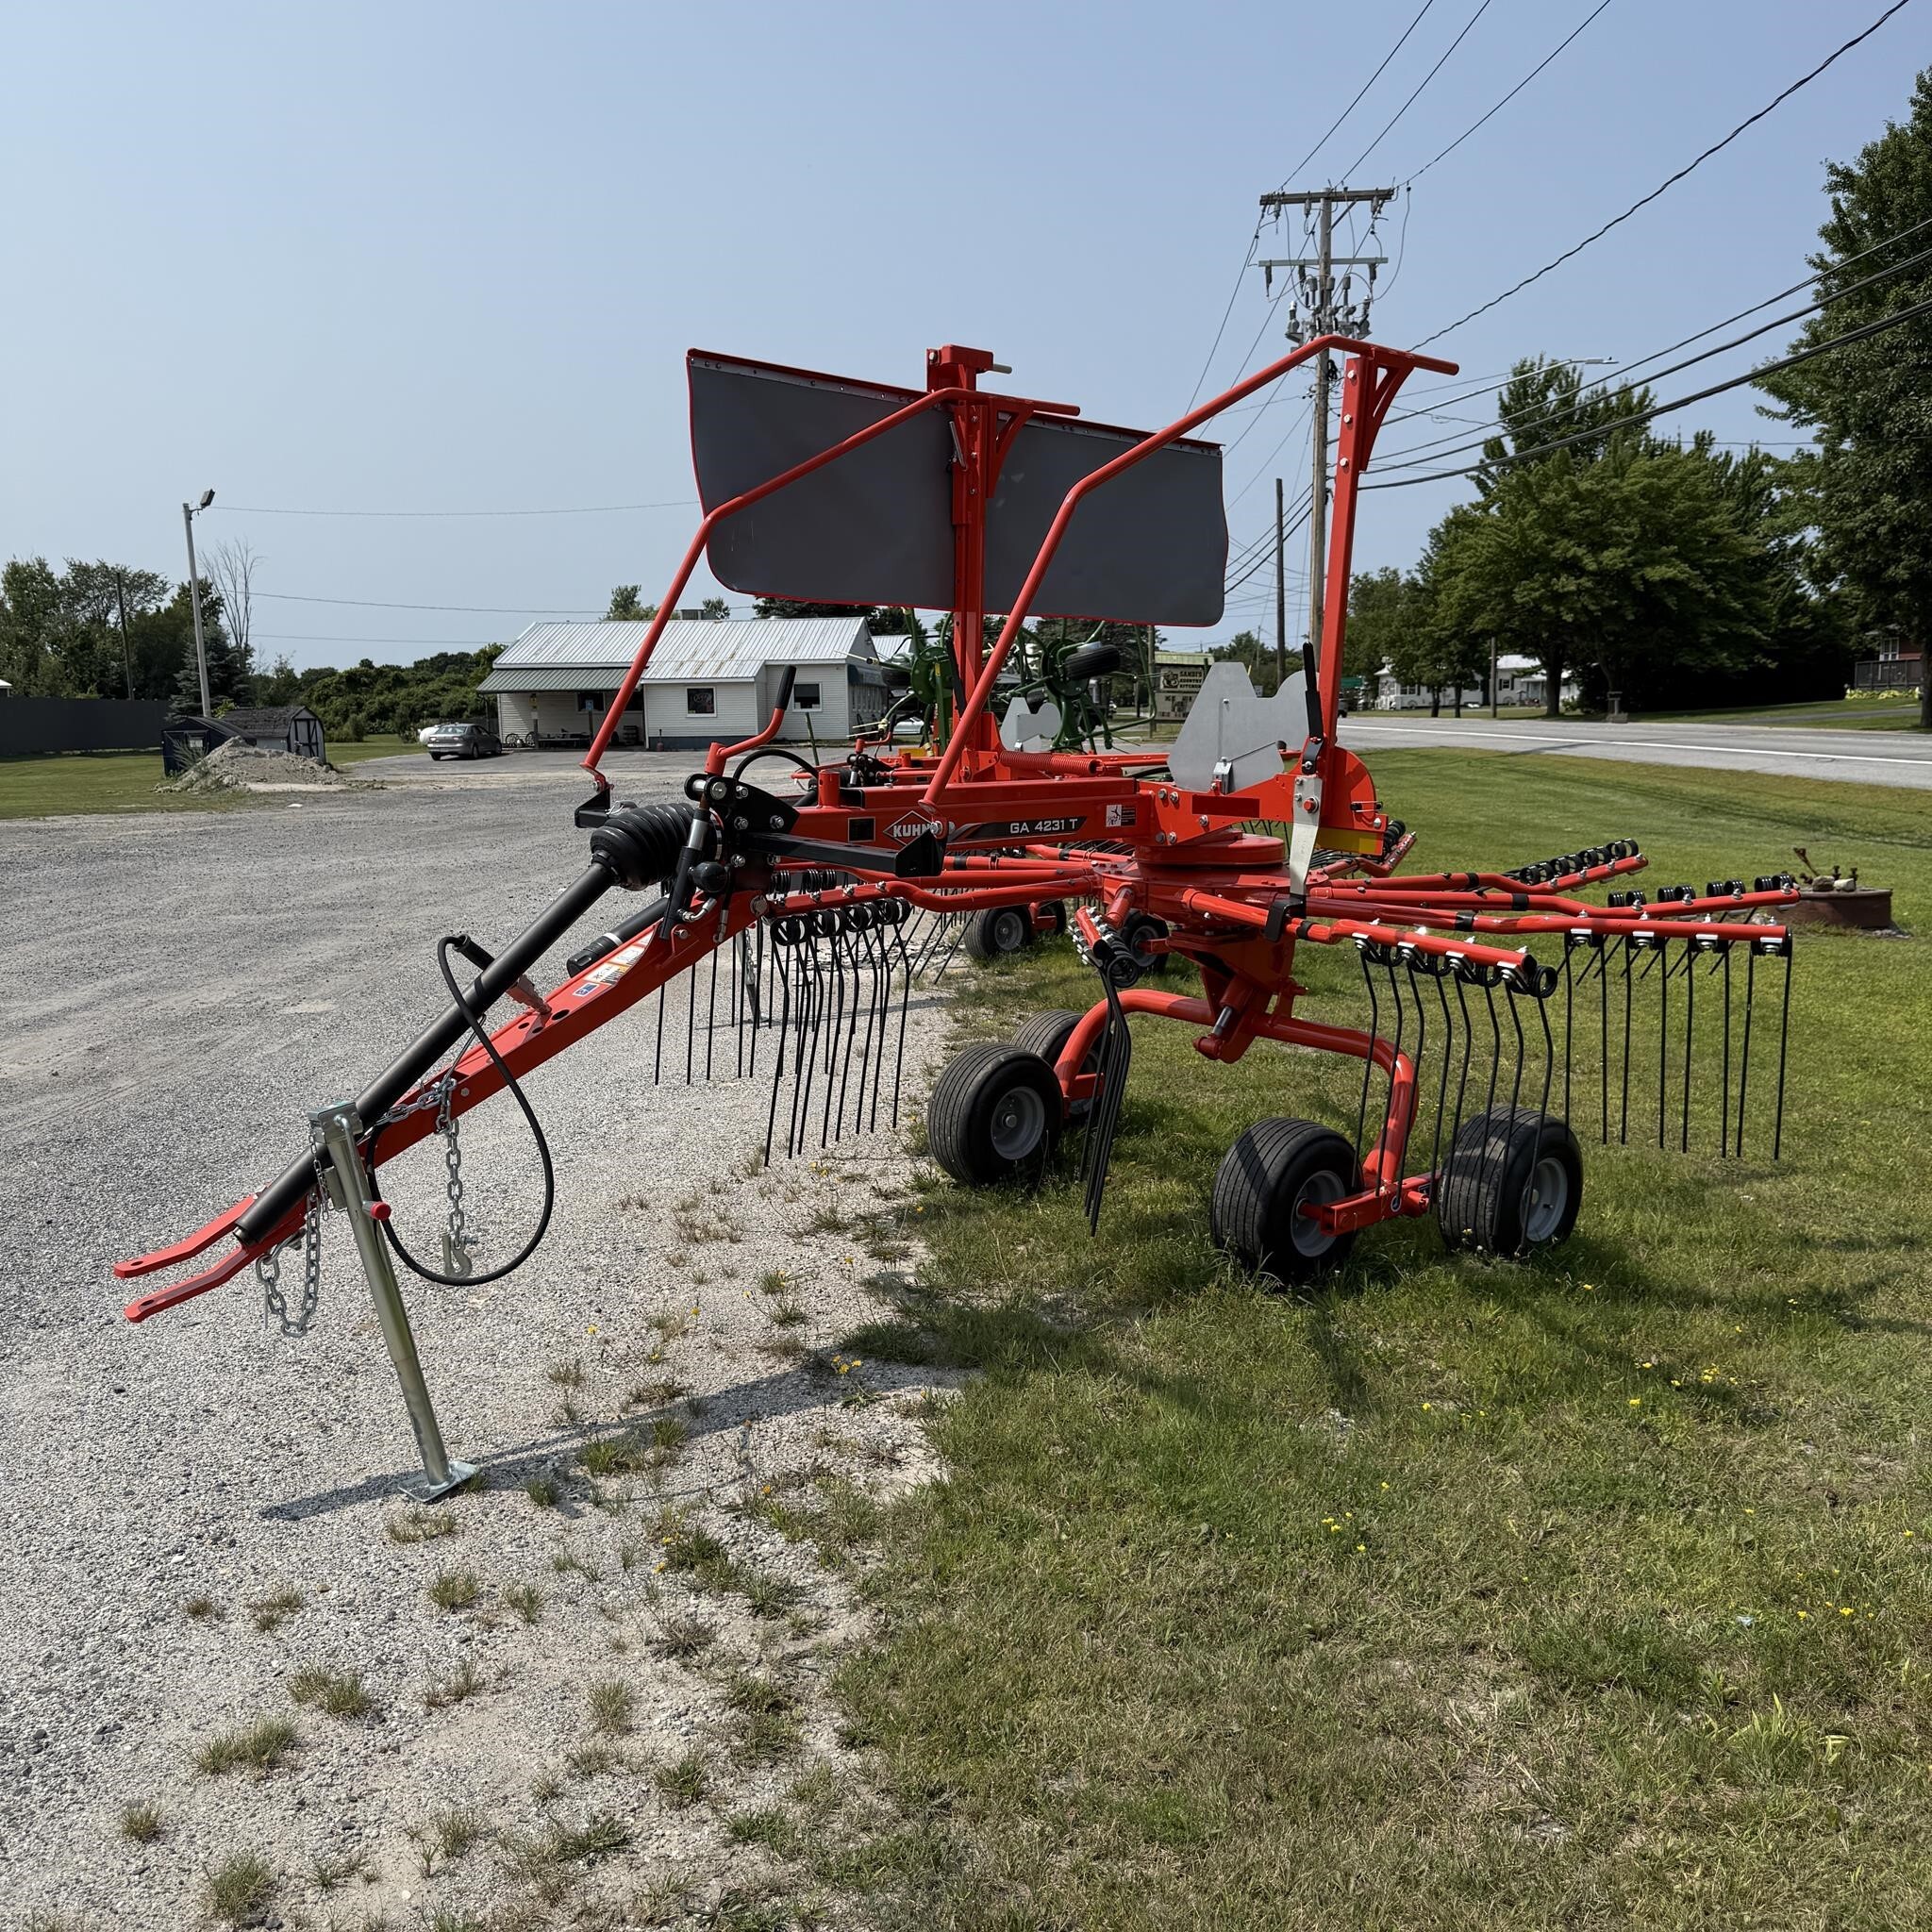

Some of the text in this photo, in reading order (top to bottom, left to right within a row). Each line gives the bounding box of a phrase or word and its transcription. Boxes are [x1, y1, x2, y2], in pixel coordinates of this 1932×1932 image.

[1010, 818, 1078, 834] GA 4231 T
